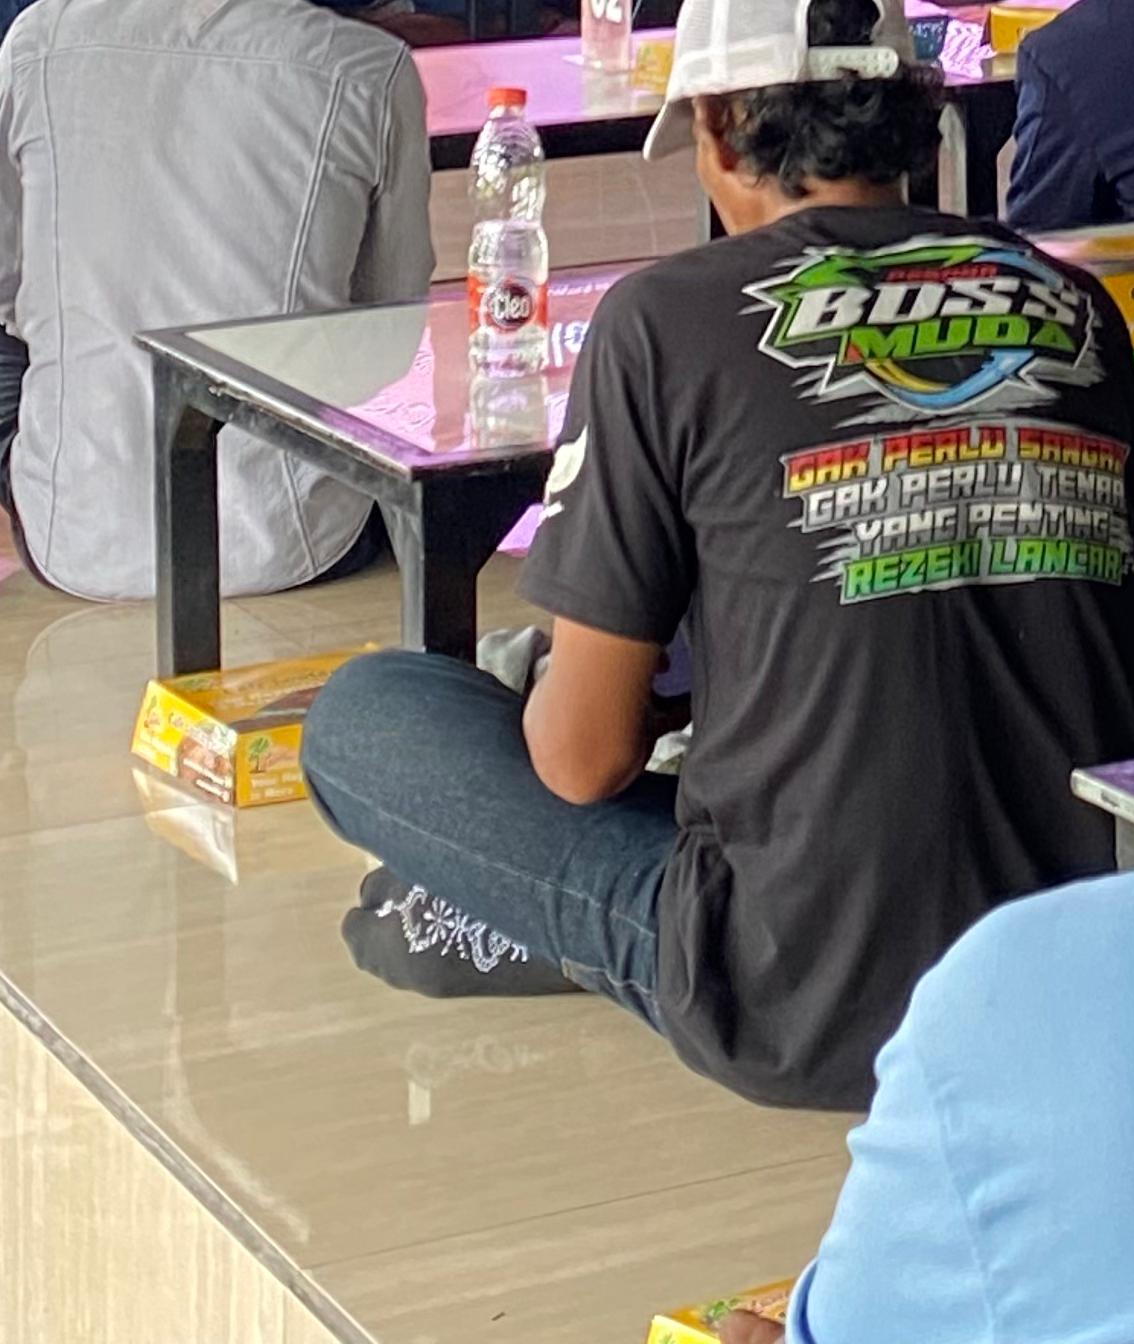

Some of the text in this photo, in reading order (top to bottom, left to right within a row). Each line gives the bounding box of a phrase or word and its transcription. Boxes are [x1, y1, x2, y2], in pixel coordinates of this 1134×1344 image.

[493, 290, 530, 320] Cleo
[785, 275, 1079, 338] BOSS
[846, 314, 1077, 363] MUDA
[789, 441, 872, 493] GAK
[883, 426, 1006, 473] PERLU
[807, 476, 888, 526] GAK
[901, 463, 1023, 507] PERLU
[855, 502, 1109, 555] YANG PENTING
[845, 539, 1122, 599] REZEKI LANCAR
